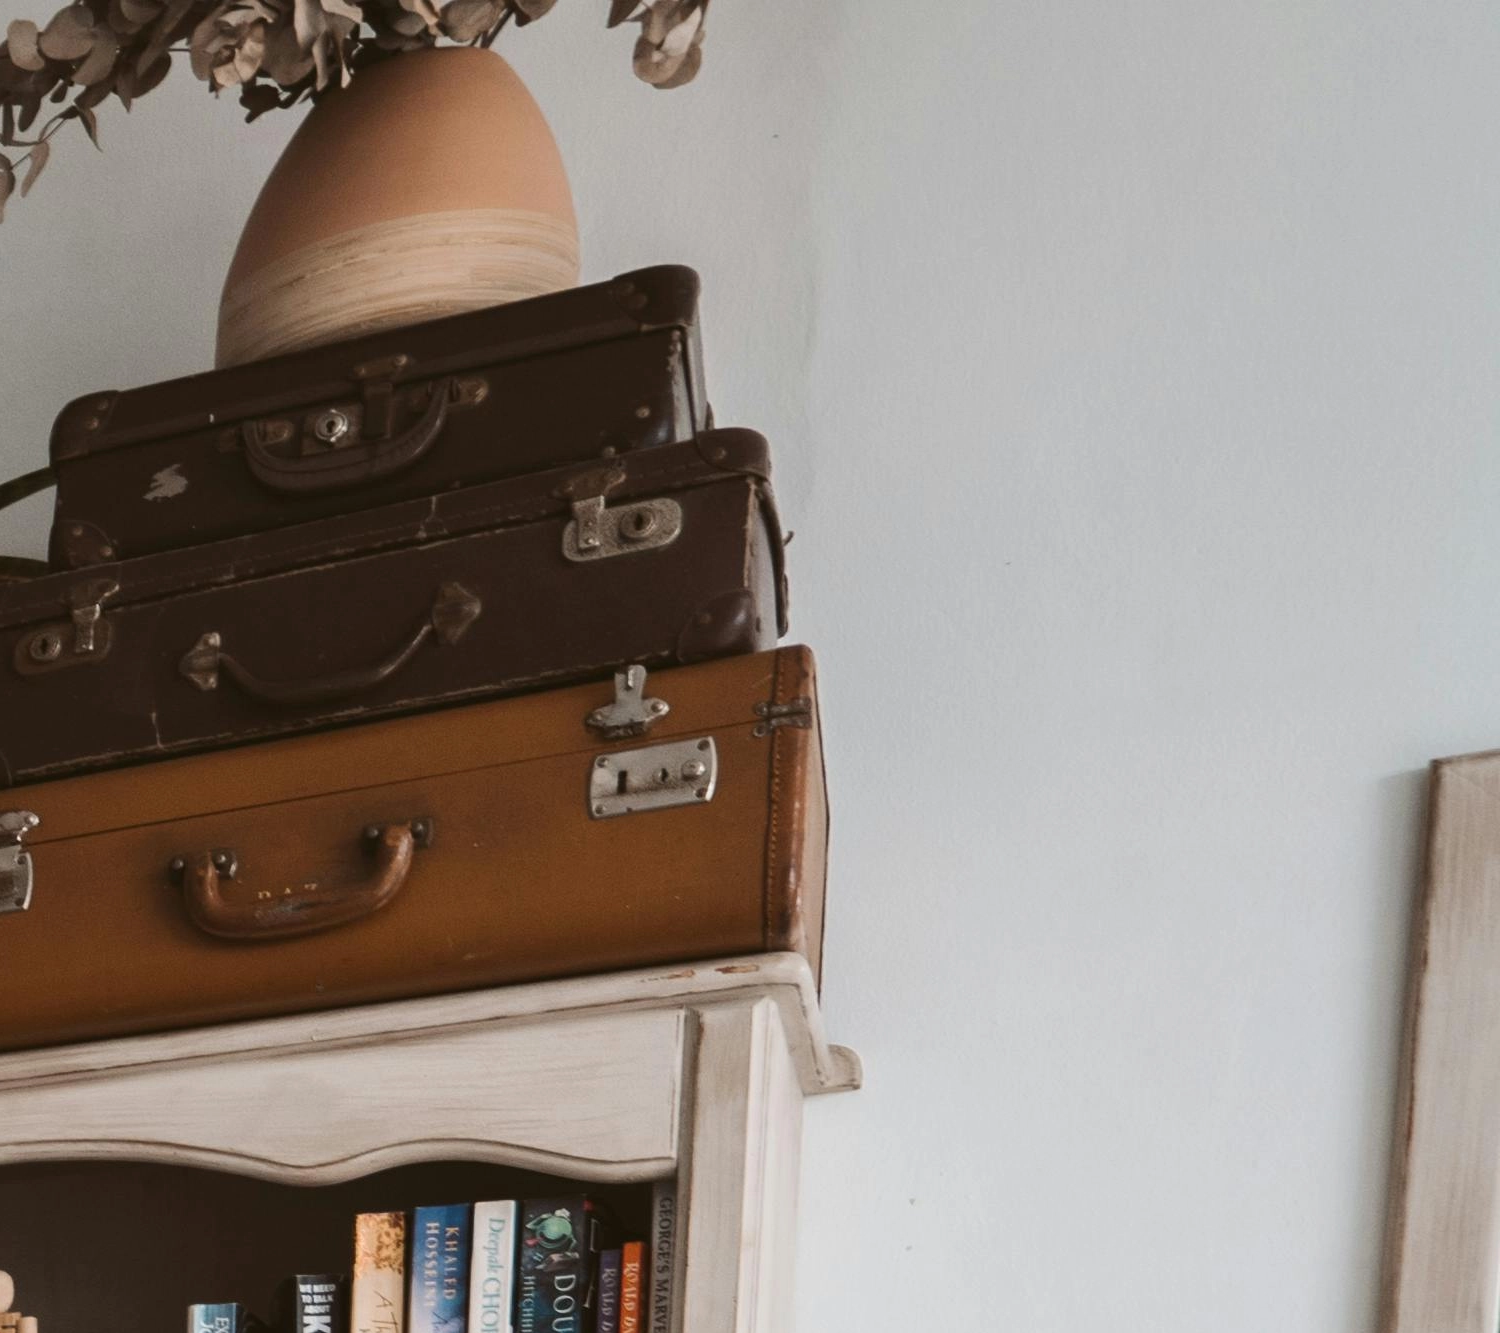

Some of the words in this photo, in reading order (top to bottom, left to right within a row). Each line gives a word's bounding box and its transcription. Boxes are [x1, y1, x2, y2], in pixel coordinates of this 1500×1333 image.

[423, 1221, 438, 1307] HOSSEINI
[444, 1226, 459, 1300] KHALED
[482, 1218, 505, 1274] Deepak
[655, 1196, 672, 1274] GEORGE'S
[374, 1290, 389, 1308] A
[622, 1261, 639, 1310] ROALD
